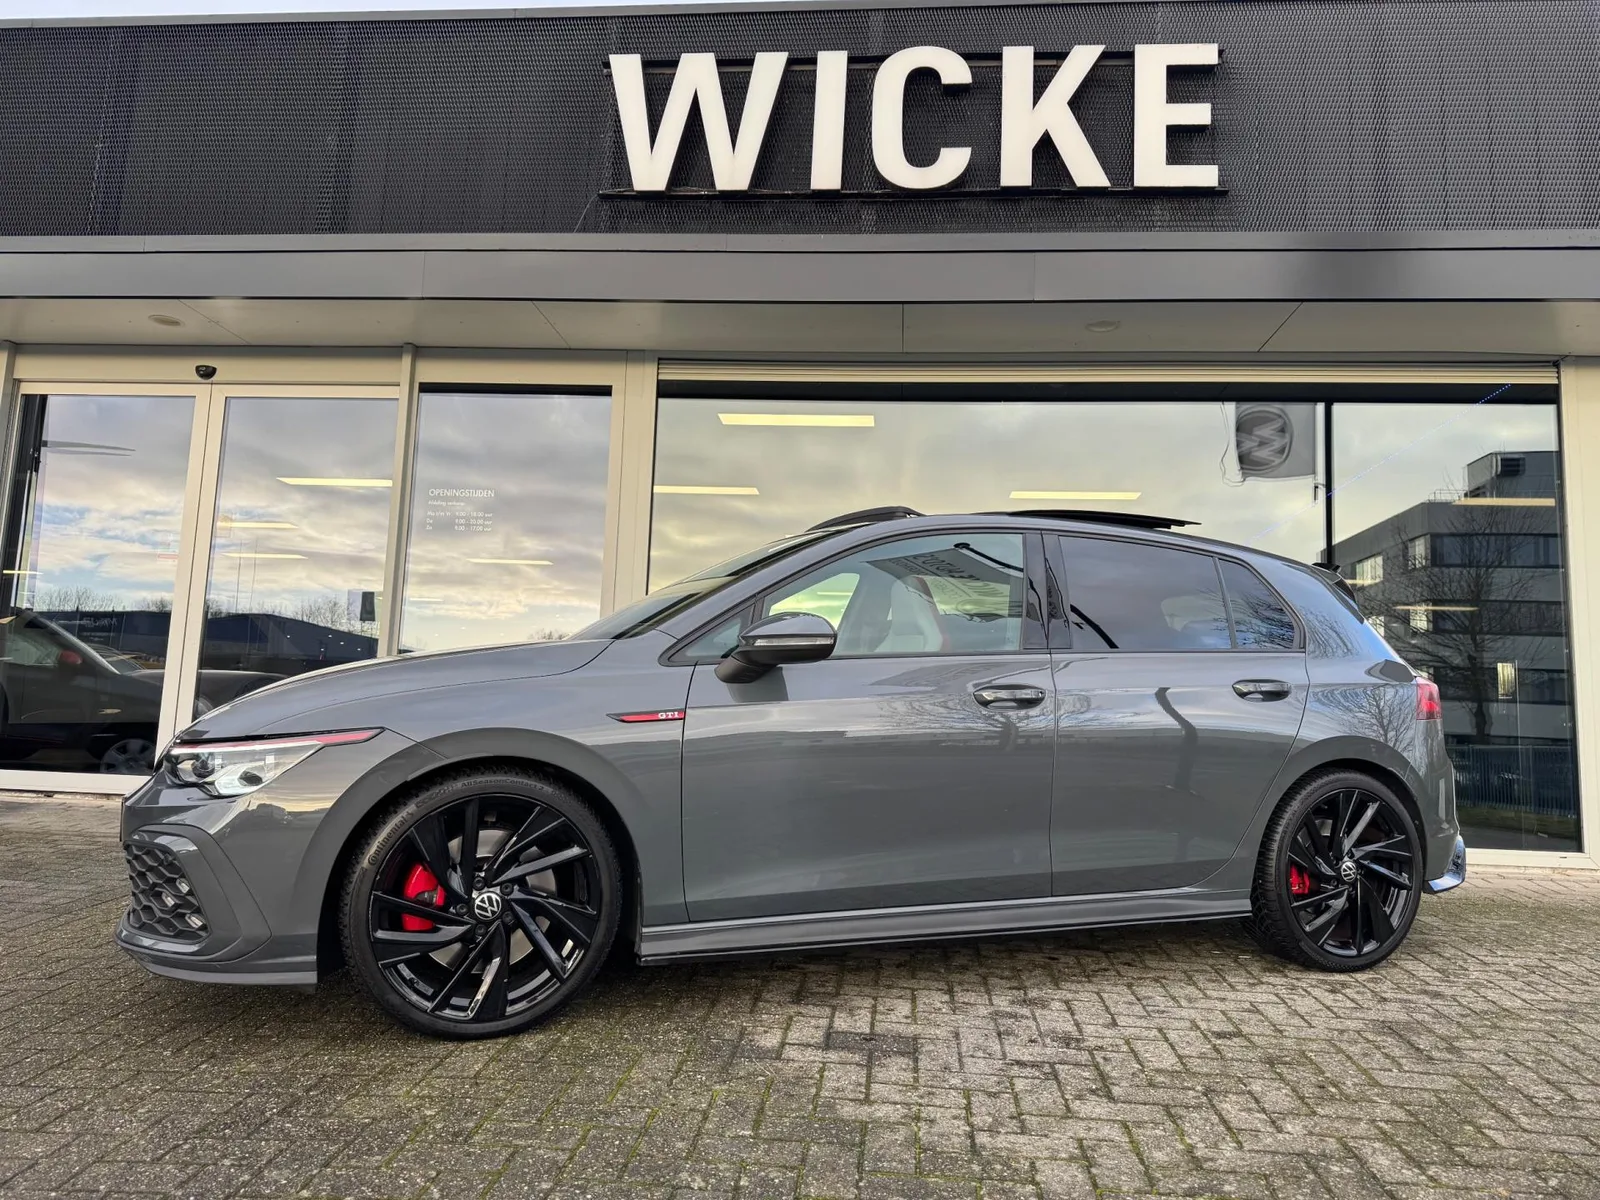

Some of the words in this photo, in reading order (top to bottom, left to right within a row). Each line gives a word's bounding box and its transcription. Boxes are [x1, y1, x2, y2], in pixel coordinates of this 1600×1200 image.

[609, 43, 1219, 191] WICKE
[428, 488, 495, 497] OPENINGSTIJDEN
[658, 711, 679, 719] GTI
[368, 815, 408, 866] Continental
